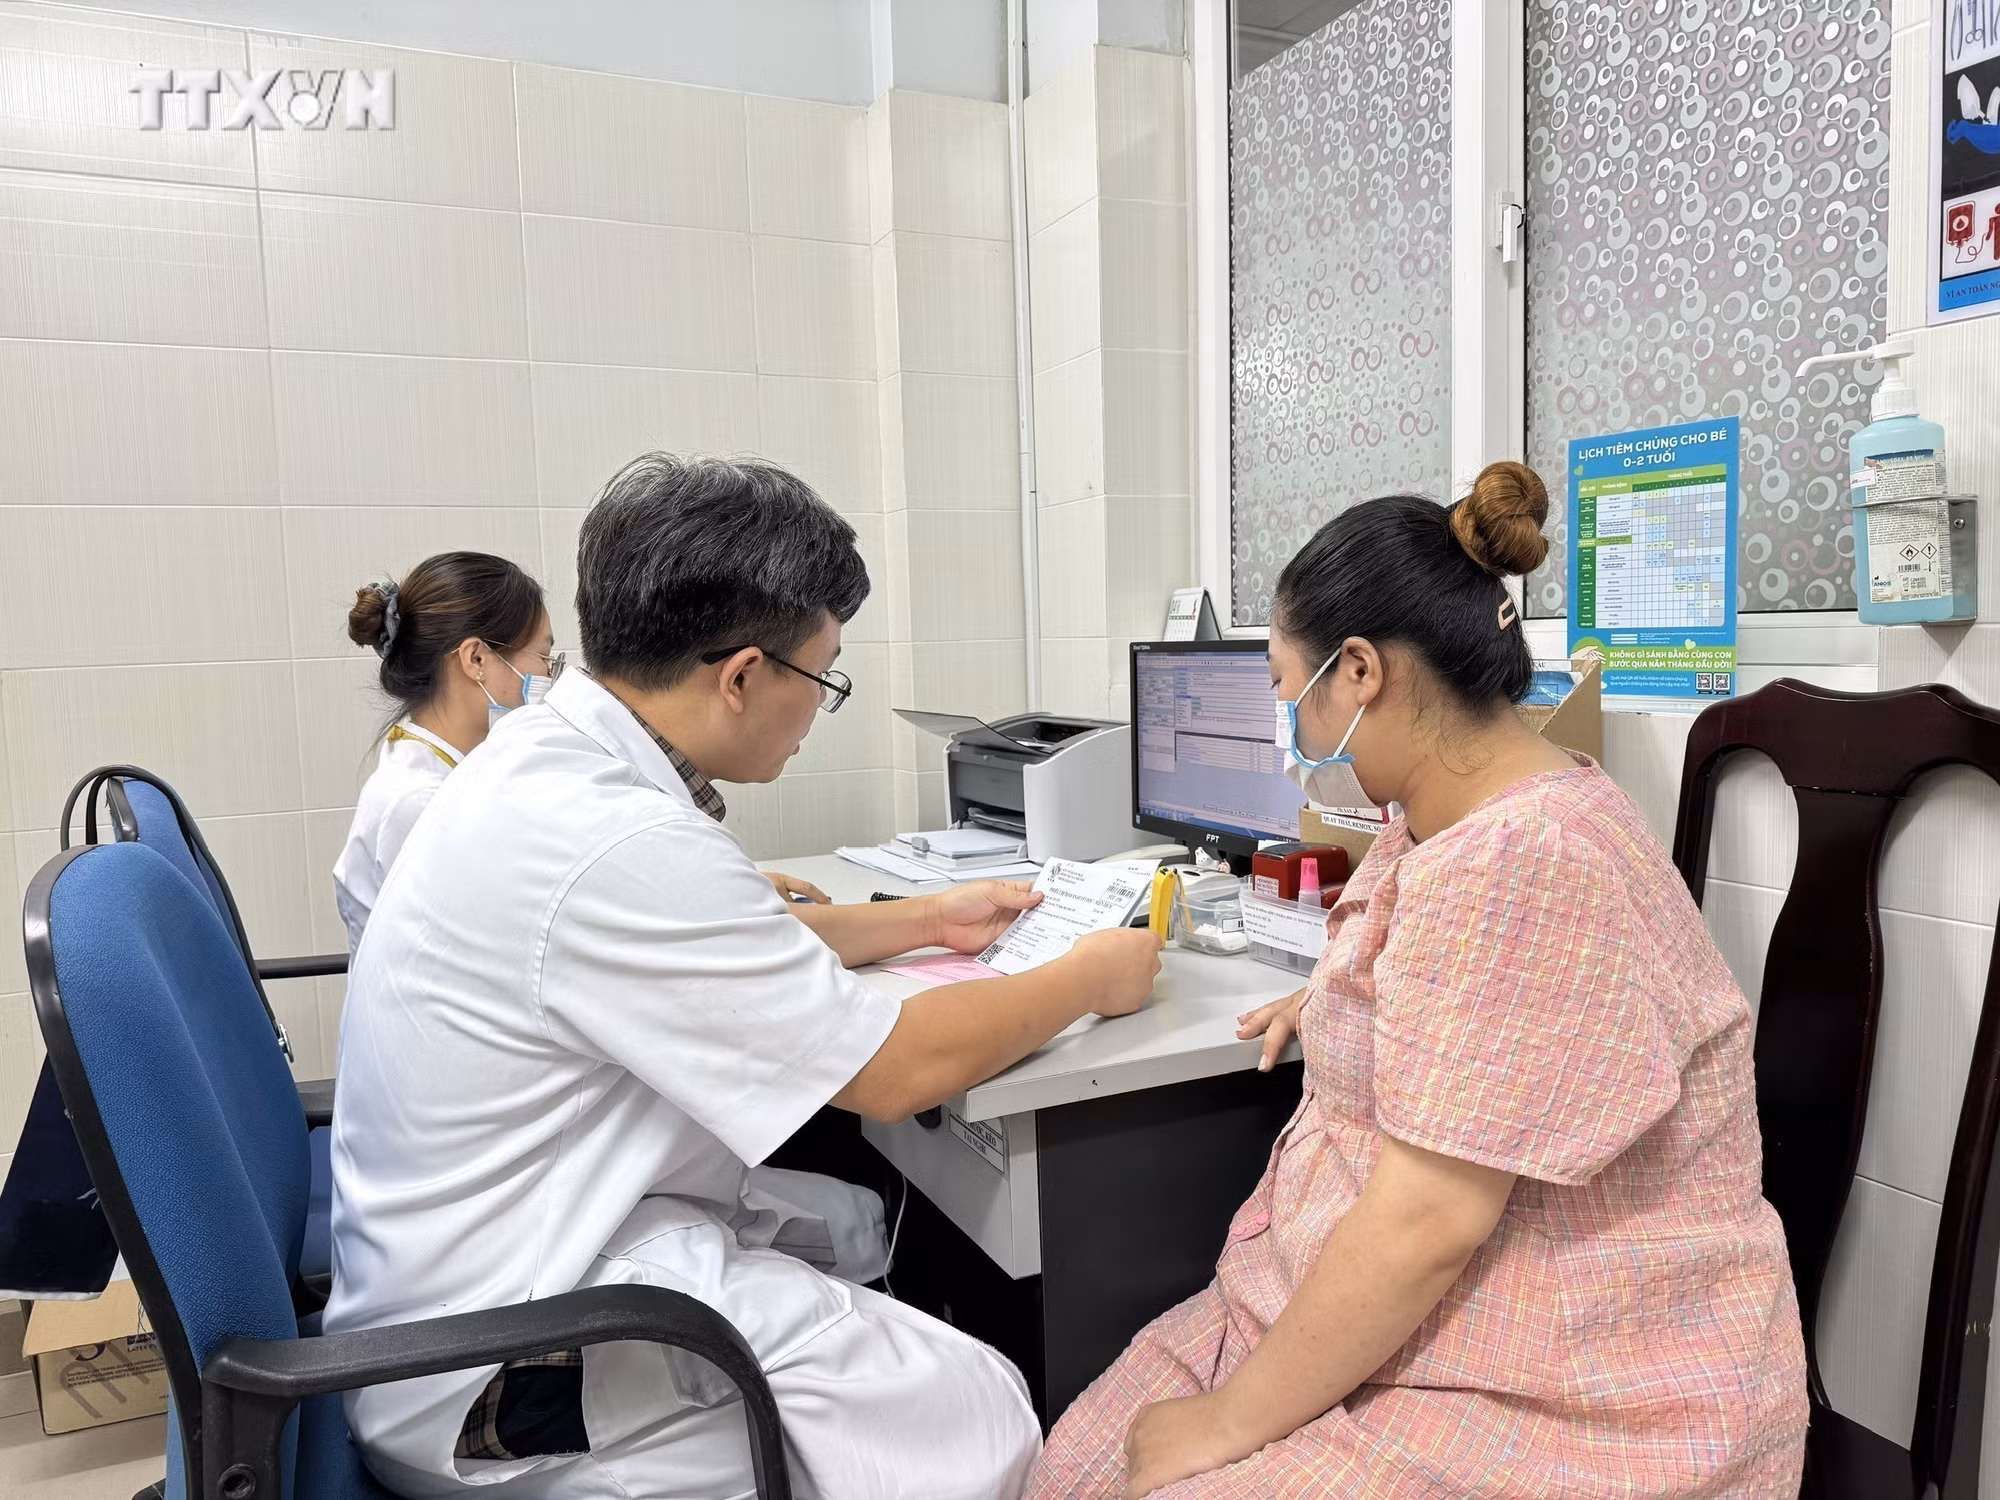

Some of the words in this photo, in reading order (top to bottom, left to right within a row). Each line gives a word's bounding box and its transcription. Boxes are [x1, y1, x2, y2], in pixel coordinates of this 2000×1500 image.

[1578, 447, 1604, 462] LỊCH
[1606, 441, 1633, 456] TIÊM
[1680, 433, 1708, 446] CHO
[1710, 427, 1728, 442] BÉ
[1623, 456, 1645, 468] 0-2
[1647, 447, 1676, 464] TUỔI
[1609, 649, 1636, 659] KHÔNG
[1636, 649, 1645, 659] GÌ
[1645, 649, 1667, 659] SÁNH
[1714, 651, 1732, 659] CON
[1631, 660, 1648, 669] QUA
[1648, 659, 1666, 668] NĂM
[1667, 659, 1694, 668] THÁNG
[1205, 833, 1220, 844] FPT
[127, 1345, 146, 1353] LATEX
